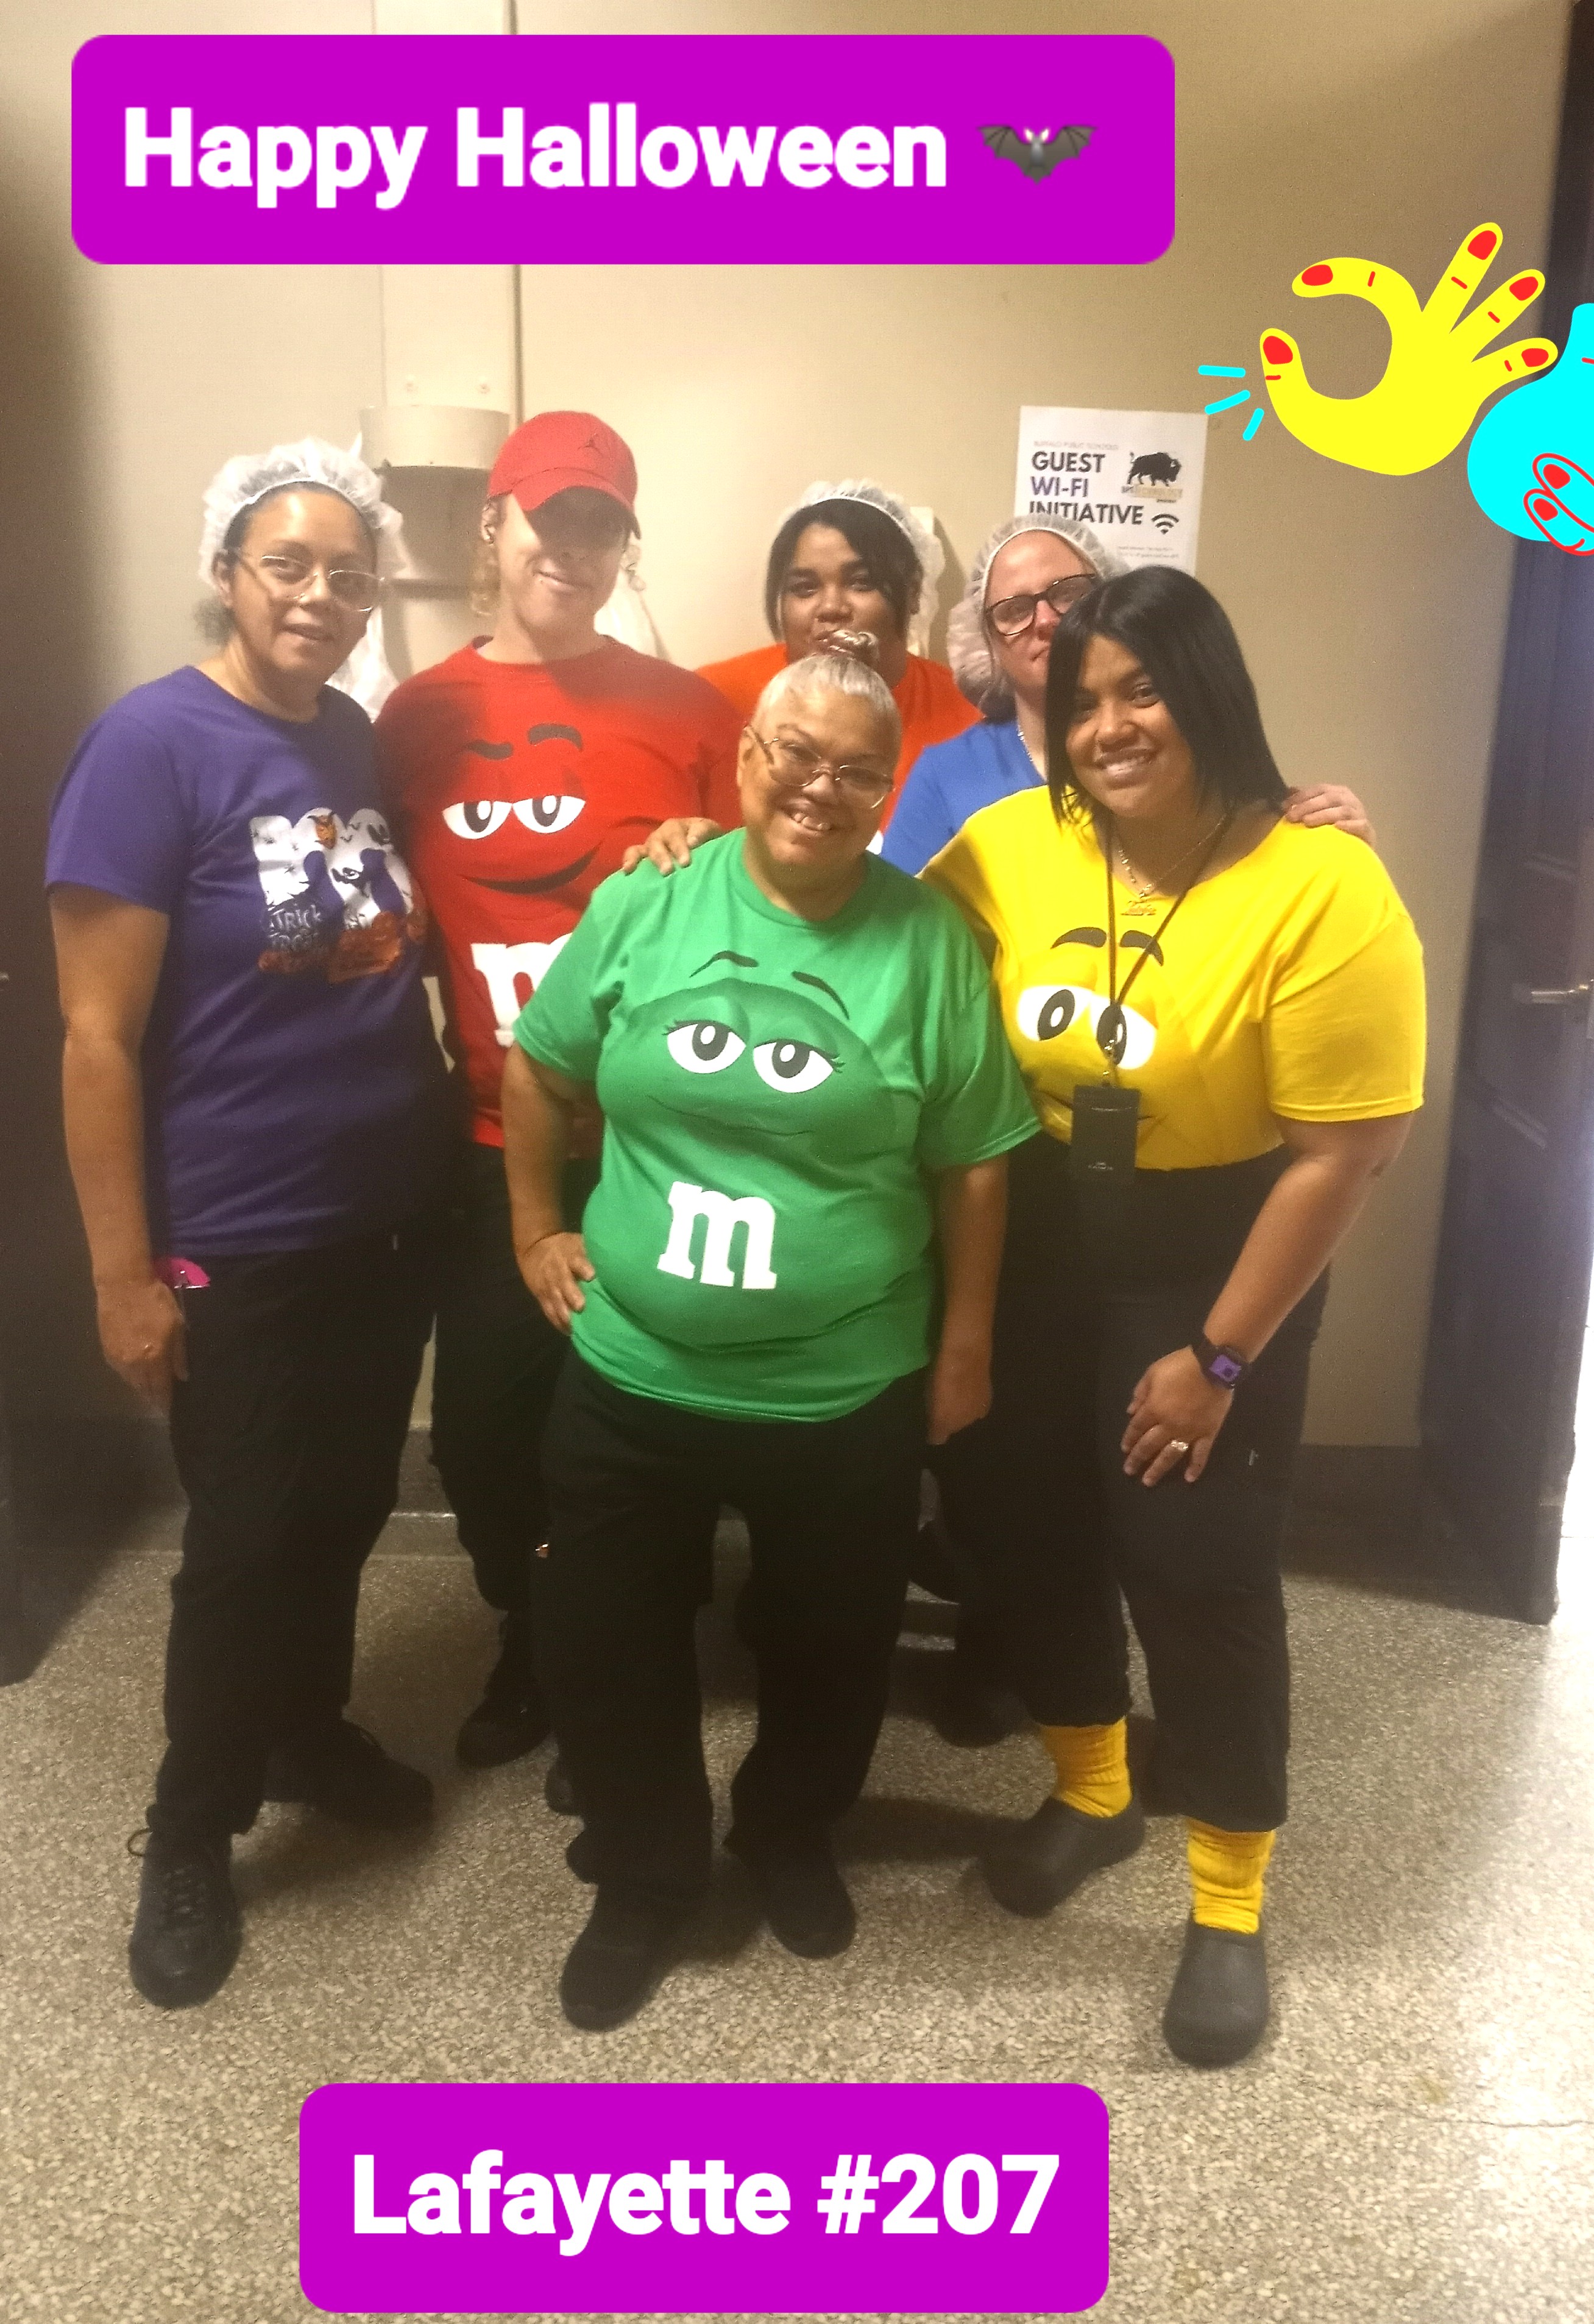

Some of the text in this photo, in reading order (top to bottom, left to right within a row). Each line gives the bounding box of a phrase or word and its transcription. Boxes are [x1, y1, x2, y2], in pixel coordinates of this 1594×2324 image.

[1032, 450, 1106, 472] GUEST
[1030, 476, 1089, 497] WI-FI
[1029, 500, 1144, 525] INITIATIVE
[656, 1180, 778, 1290] m
